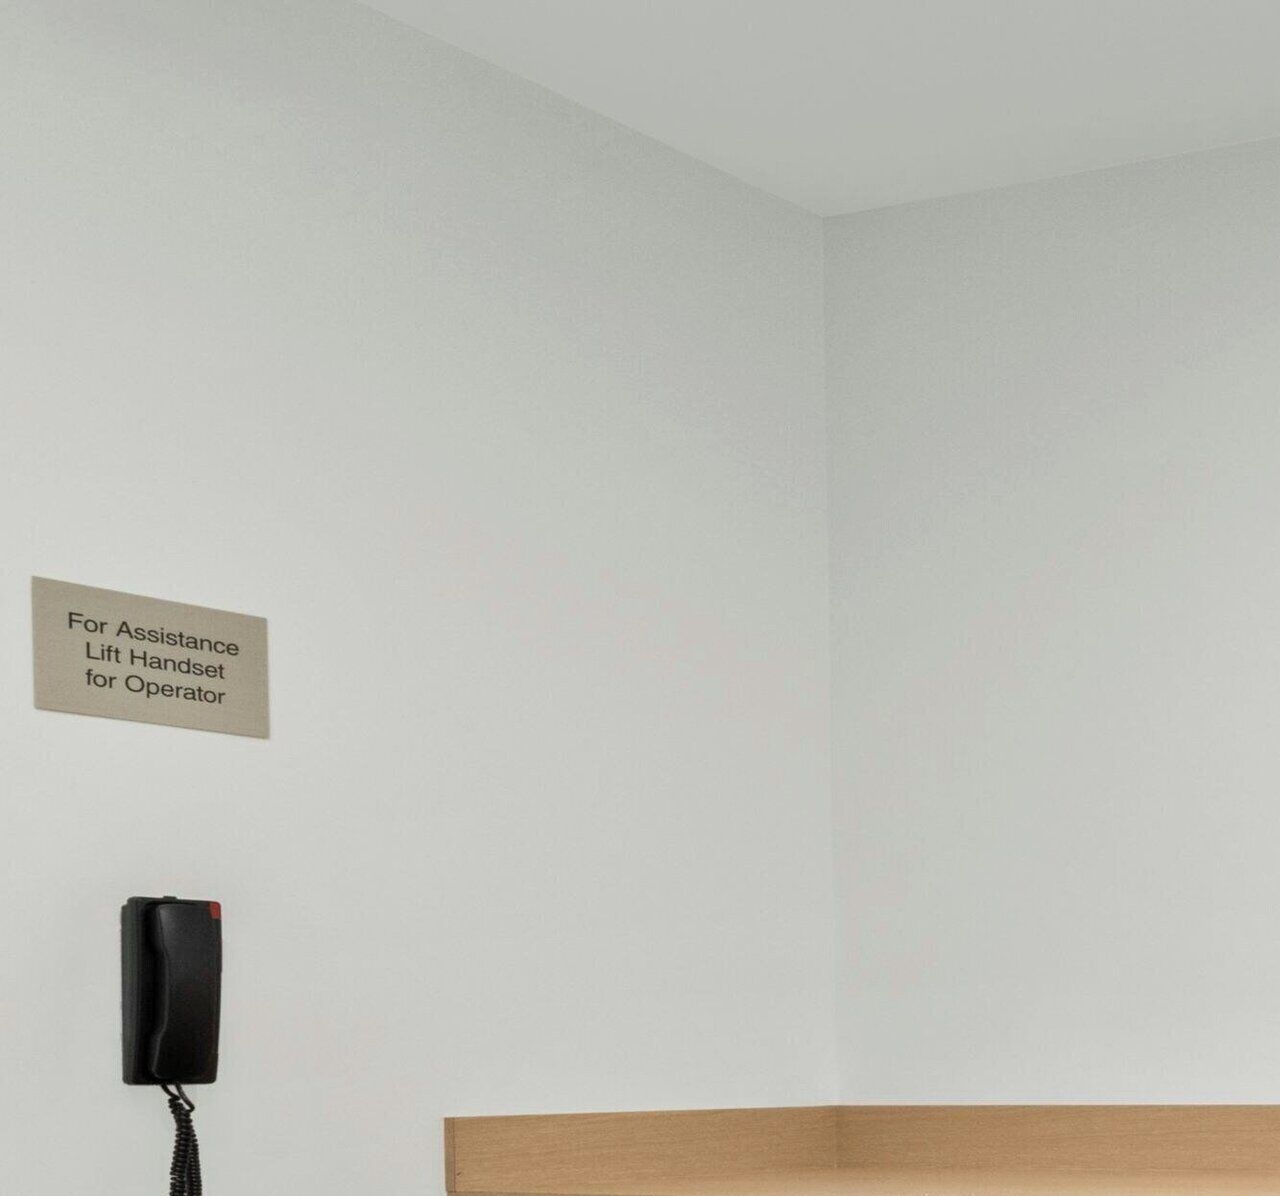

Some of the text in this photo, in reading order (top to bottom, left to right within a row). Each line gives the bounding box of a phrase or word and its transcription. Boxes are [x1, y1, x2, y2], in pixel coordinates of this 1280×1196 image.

[67, 611, 240, 656] For Assistance
[85, 641, 225, 680] Lift Handset
[85, 668, 226, 705] for Operator
